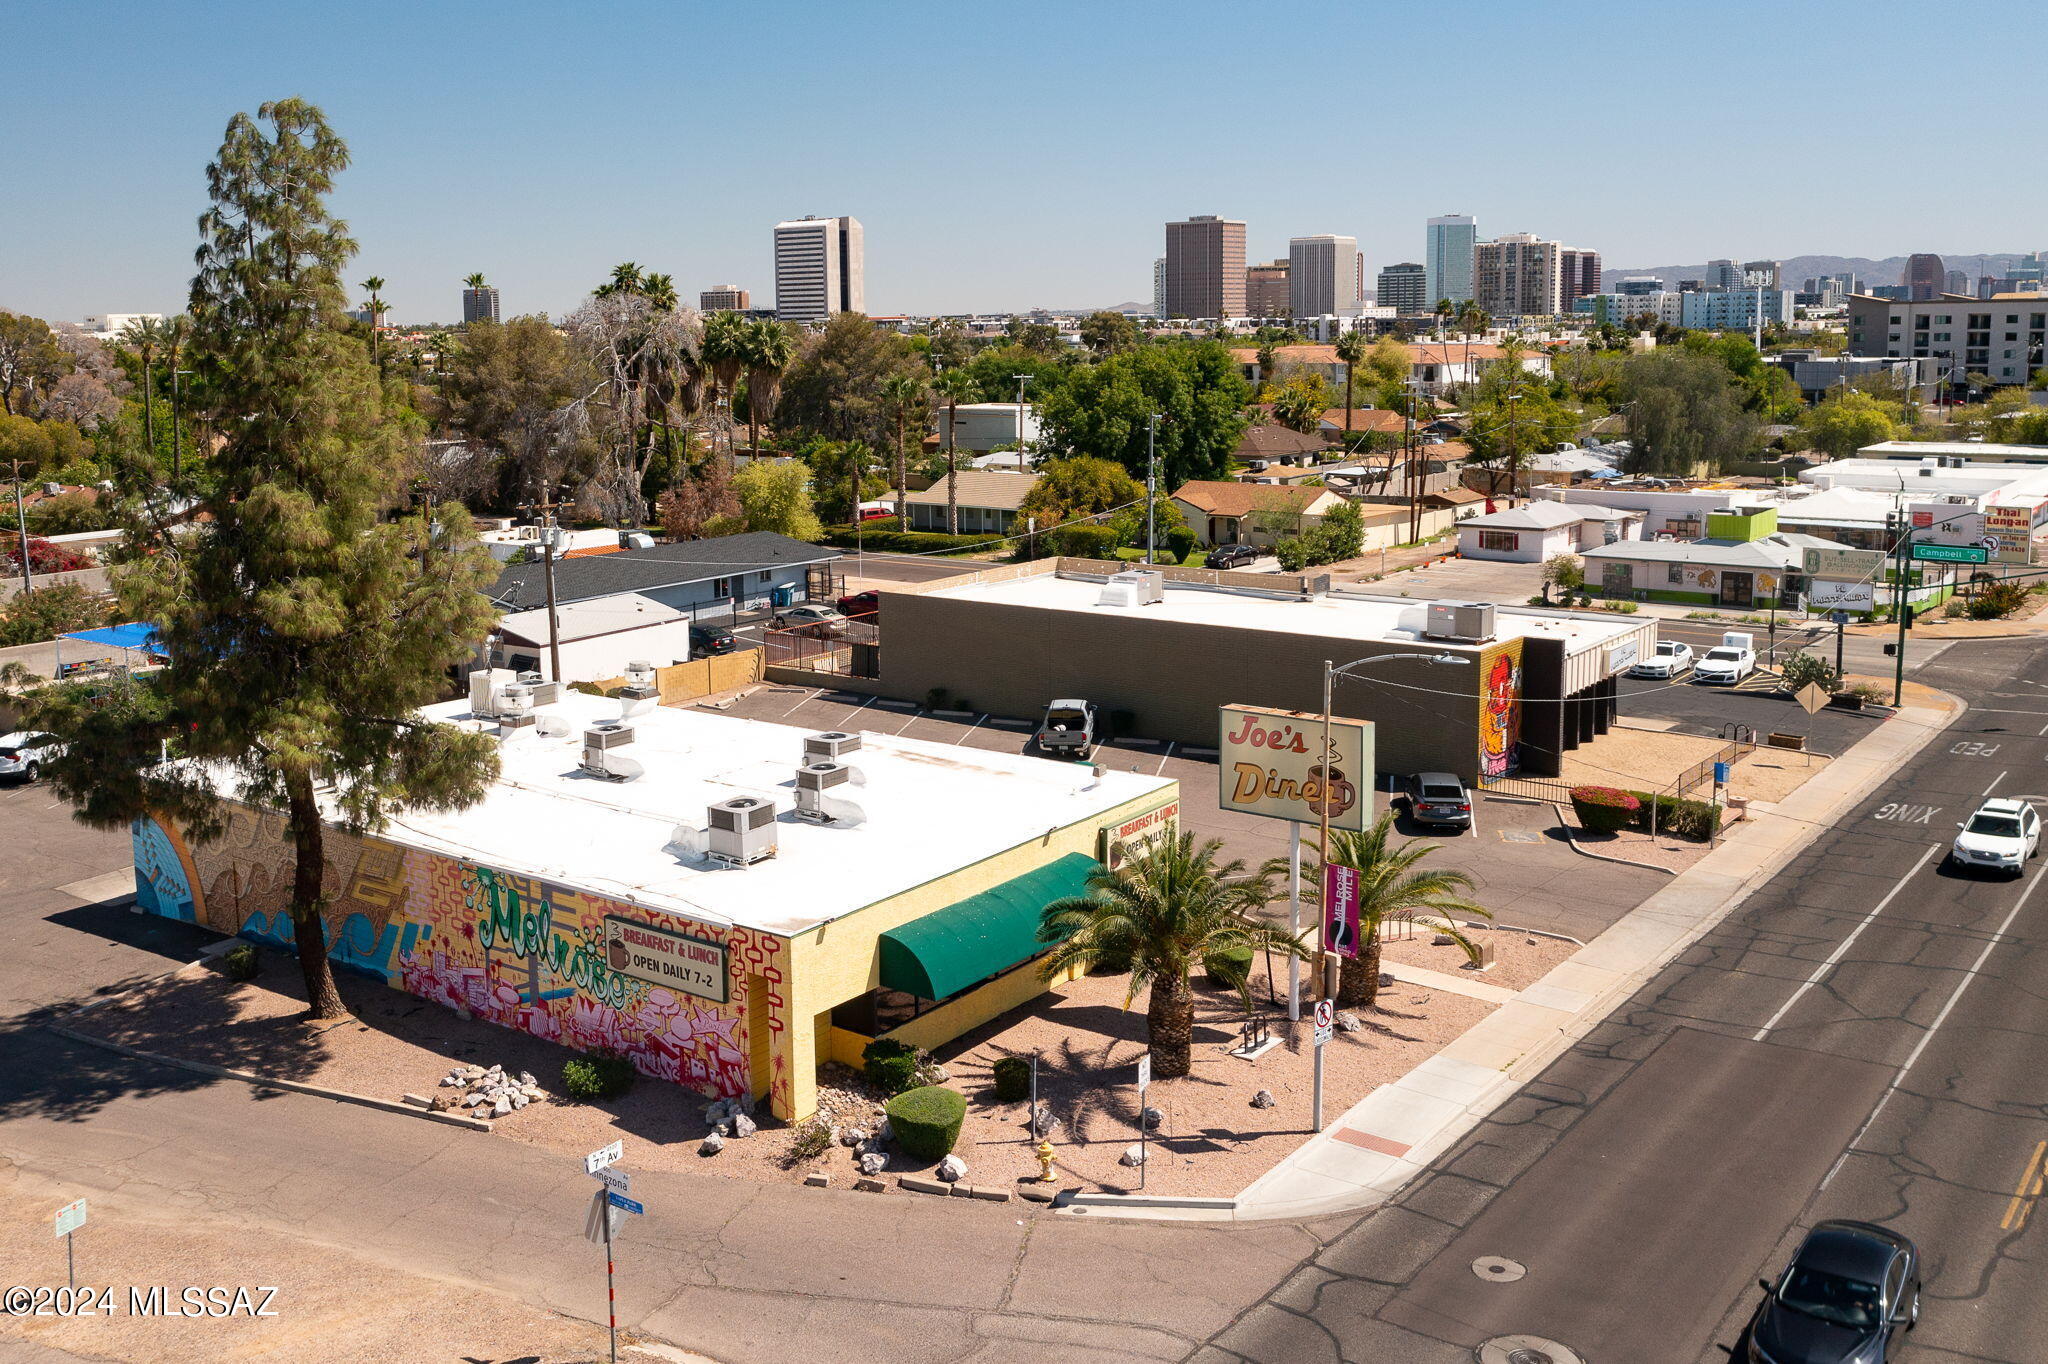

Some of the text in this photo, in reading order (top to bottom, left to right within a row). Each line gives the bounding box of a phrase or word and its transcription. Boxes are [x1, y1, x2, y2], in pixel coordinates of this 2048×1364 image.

[1996, 507, 2020, 517] Thai
[1920, 548, 1962, 558] Campbell
[1228, 715, 1310, 753] Joe's
[1949, 741, 2001, 757] PED
[1231, 761, 1341, 804] Diner
[1120, 803, 1178, 839] BREAKFAST & LUNCH
[1874, 803, 1943, 824] XING
[1333, 866, 1344, 922] MELROSE
[1345, 869, 1354, 901] MILE
[478, 882, 626, 1011] Melrose
[623, 928, 720, 966] BREAKFAST & LUNCH
[633, 954, 713, 988] OPEN DAILY 7-2
[592, 1170, 628, 1191] nnezona
